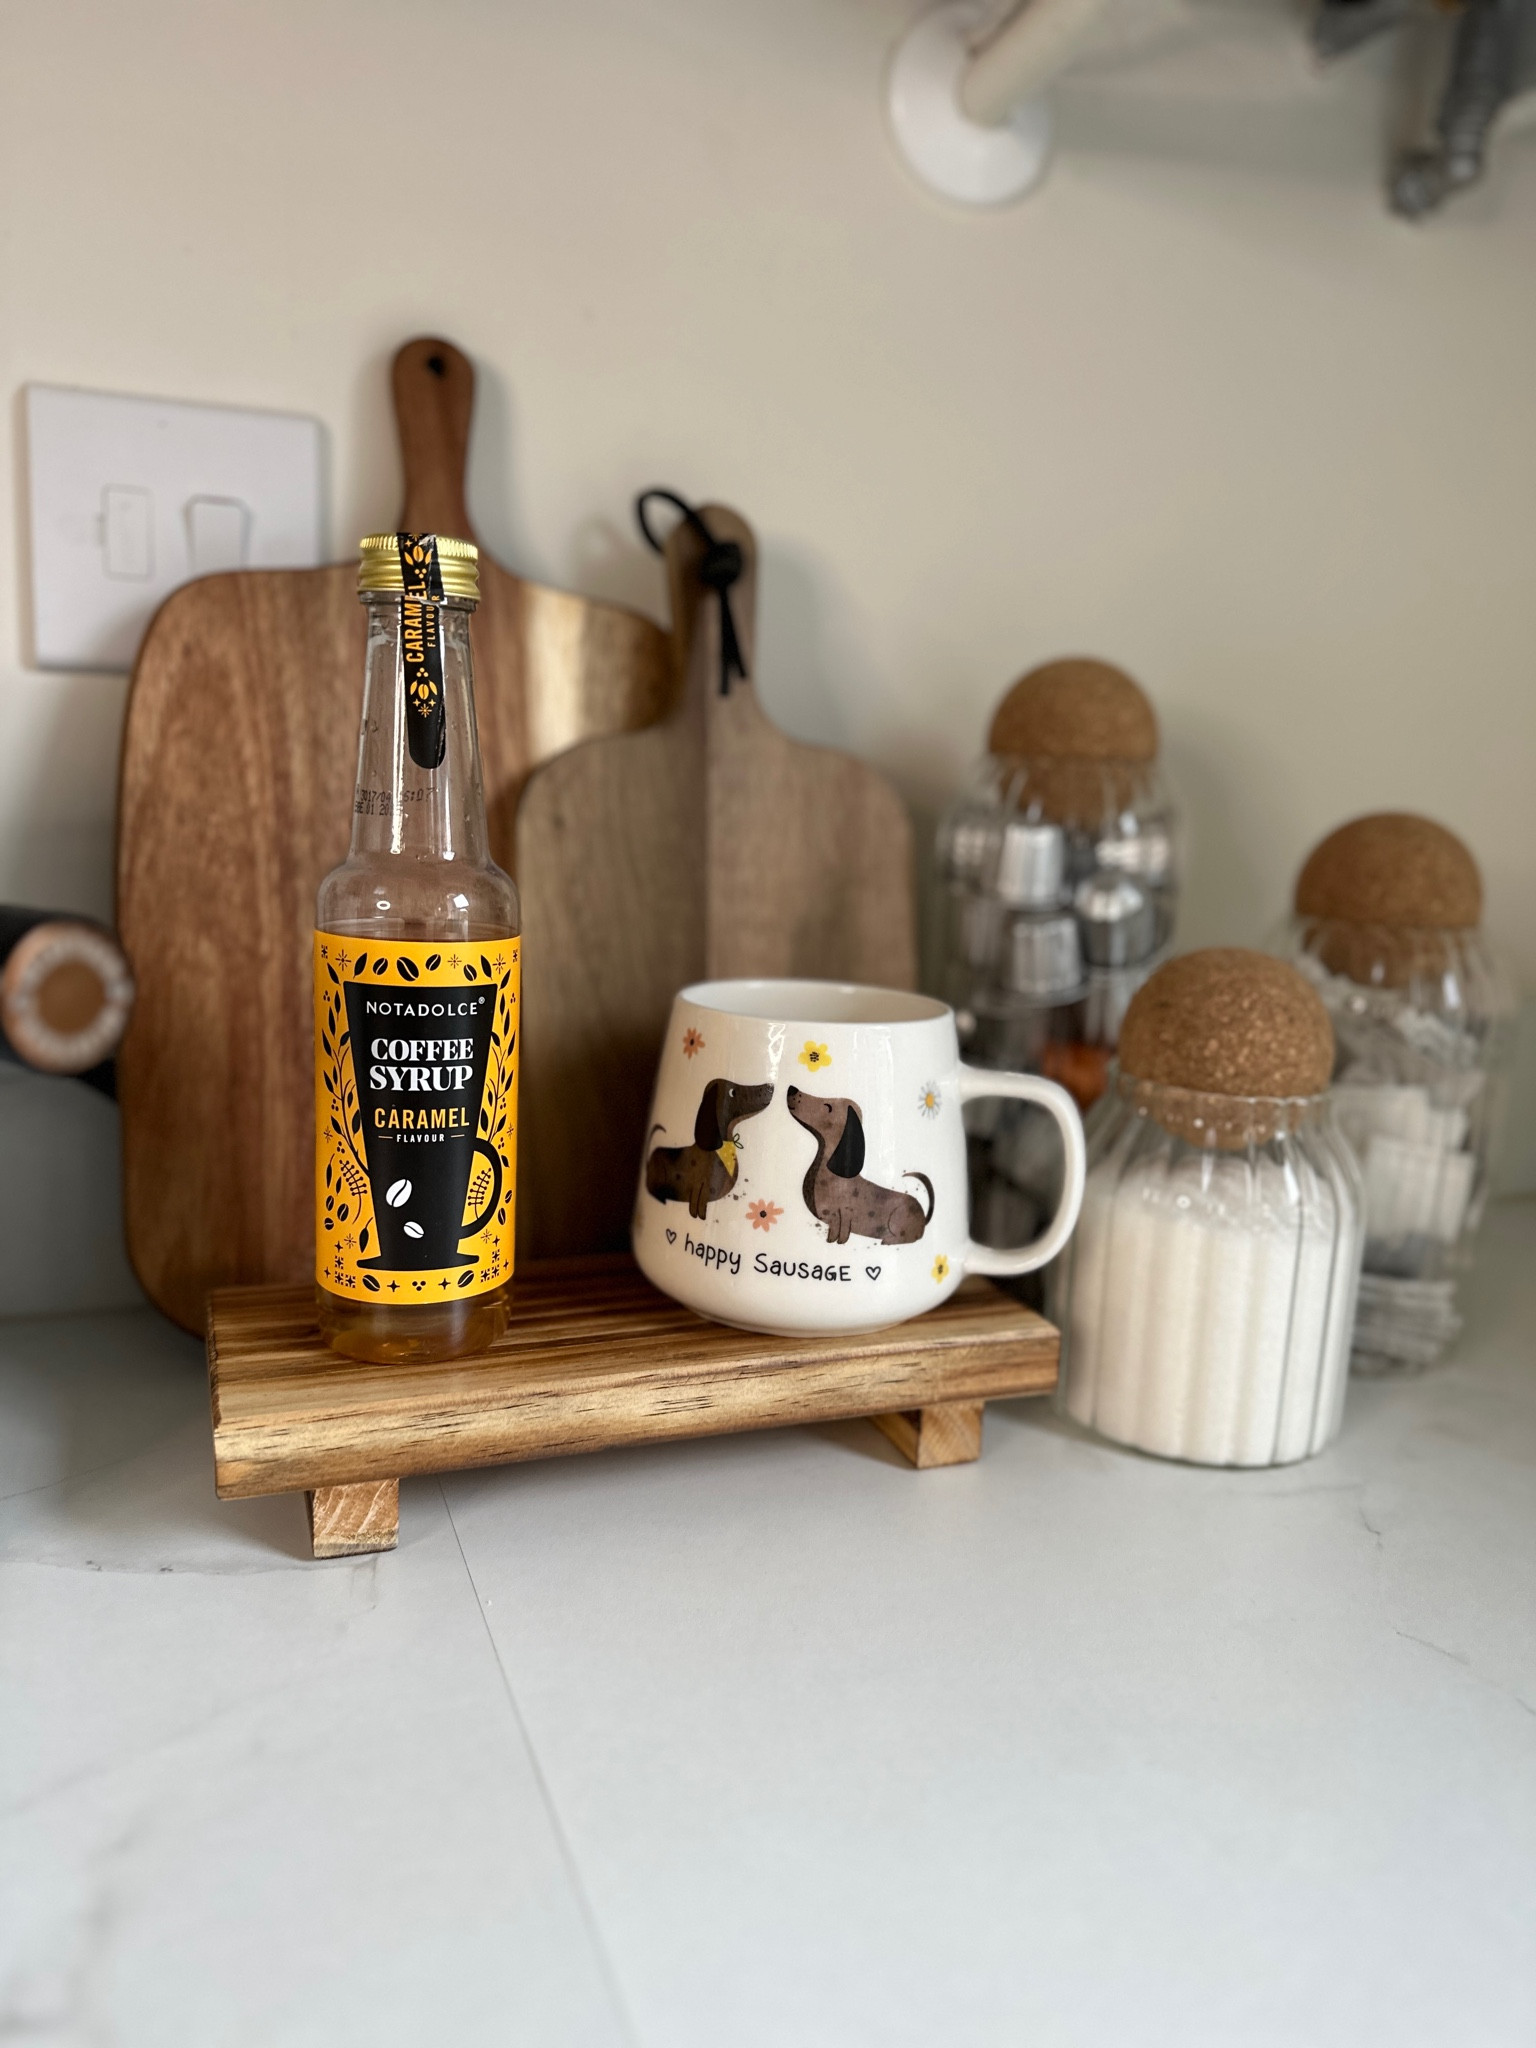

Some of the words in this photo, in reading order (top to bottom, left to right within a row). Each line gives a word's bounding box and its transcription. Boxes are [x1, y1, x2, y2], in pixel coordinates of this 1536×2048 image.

[404, 581, 427, 663] CARAMEL
[426, 595, 440, 648] FLAVOUR
[370, 1037, 474, 1062] COFFEE
[369, 1064, 474, 1092] SYRUP
[374, 1106, 470, 1130] CARAMEL
[396, 1133, 445, 1143] FLAVOUR
[684, 1233, 741, 1275] happy
